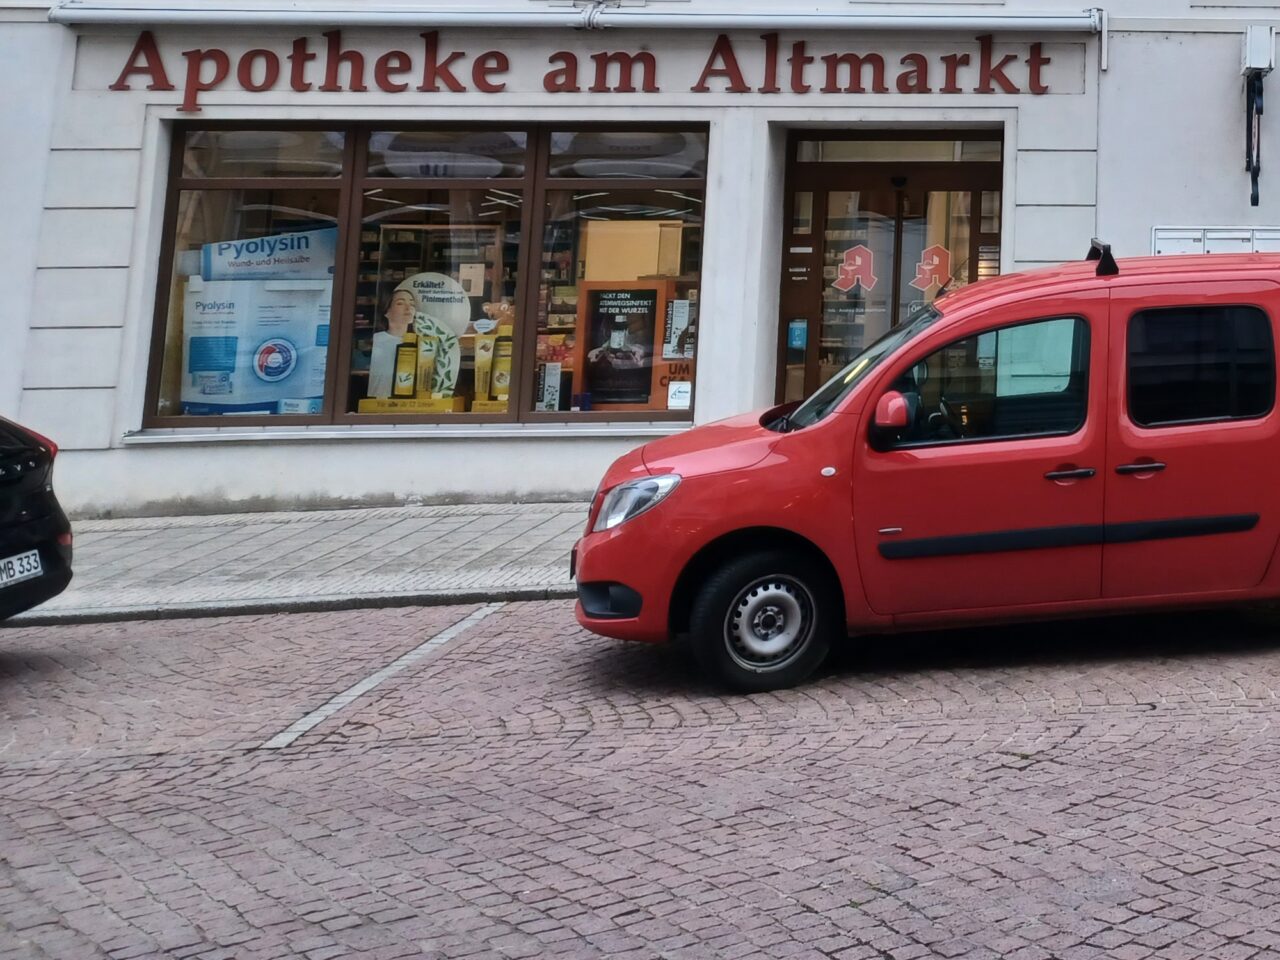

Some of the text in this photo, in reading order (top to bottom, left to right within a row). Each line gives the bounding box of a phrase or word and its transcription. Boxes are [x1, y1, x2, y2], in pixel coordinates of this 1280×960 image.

[109, 30, 1051, 112] Apotheke am Altmarkt
[218, 233, 310, 259] Pyolysin
[255, 257, 272, 266] und
[195, 300, 235, 312] Pyolysin
[17, 552, 39, 575] 333
